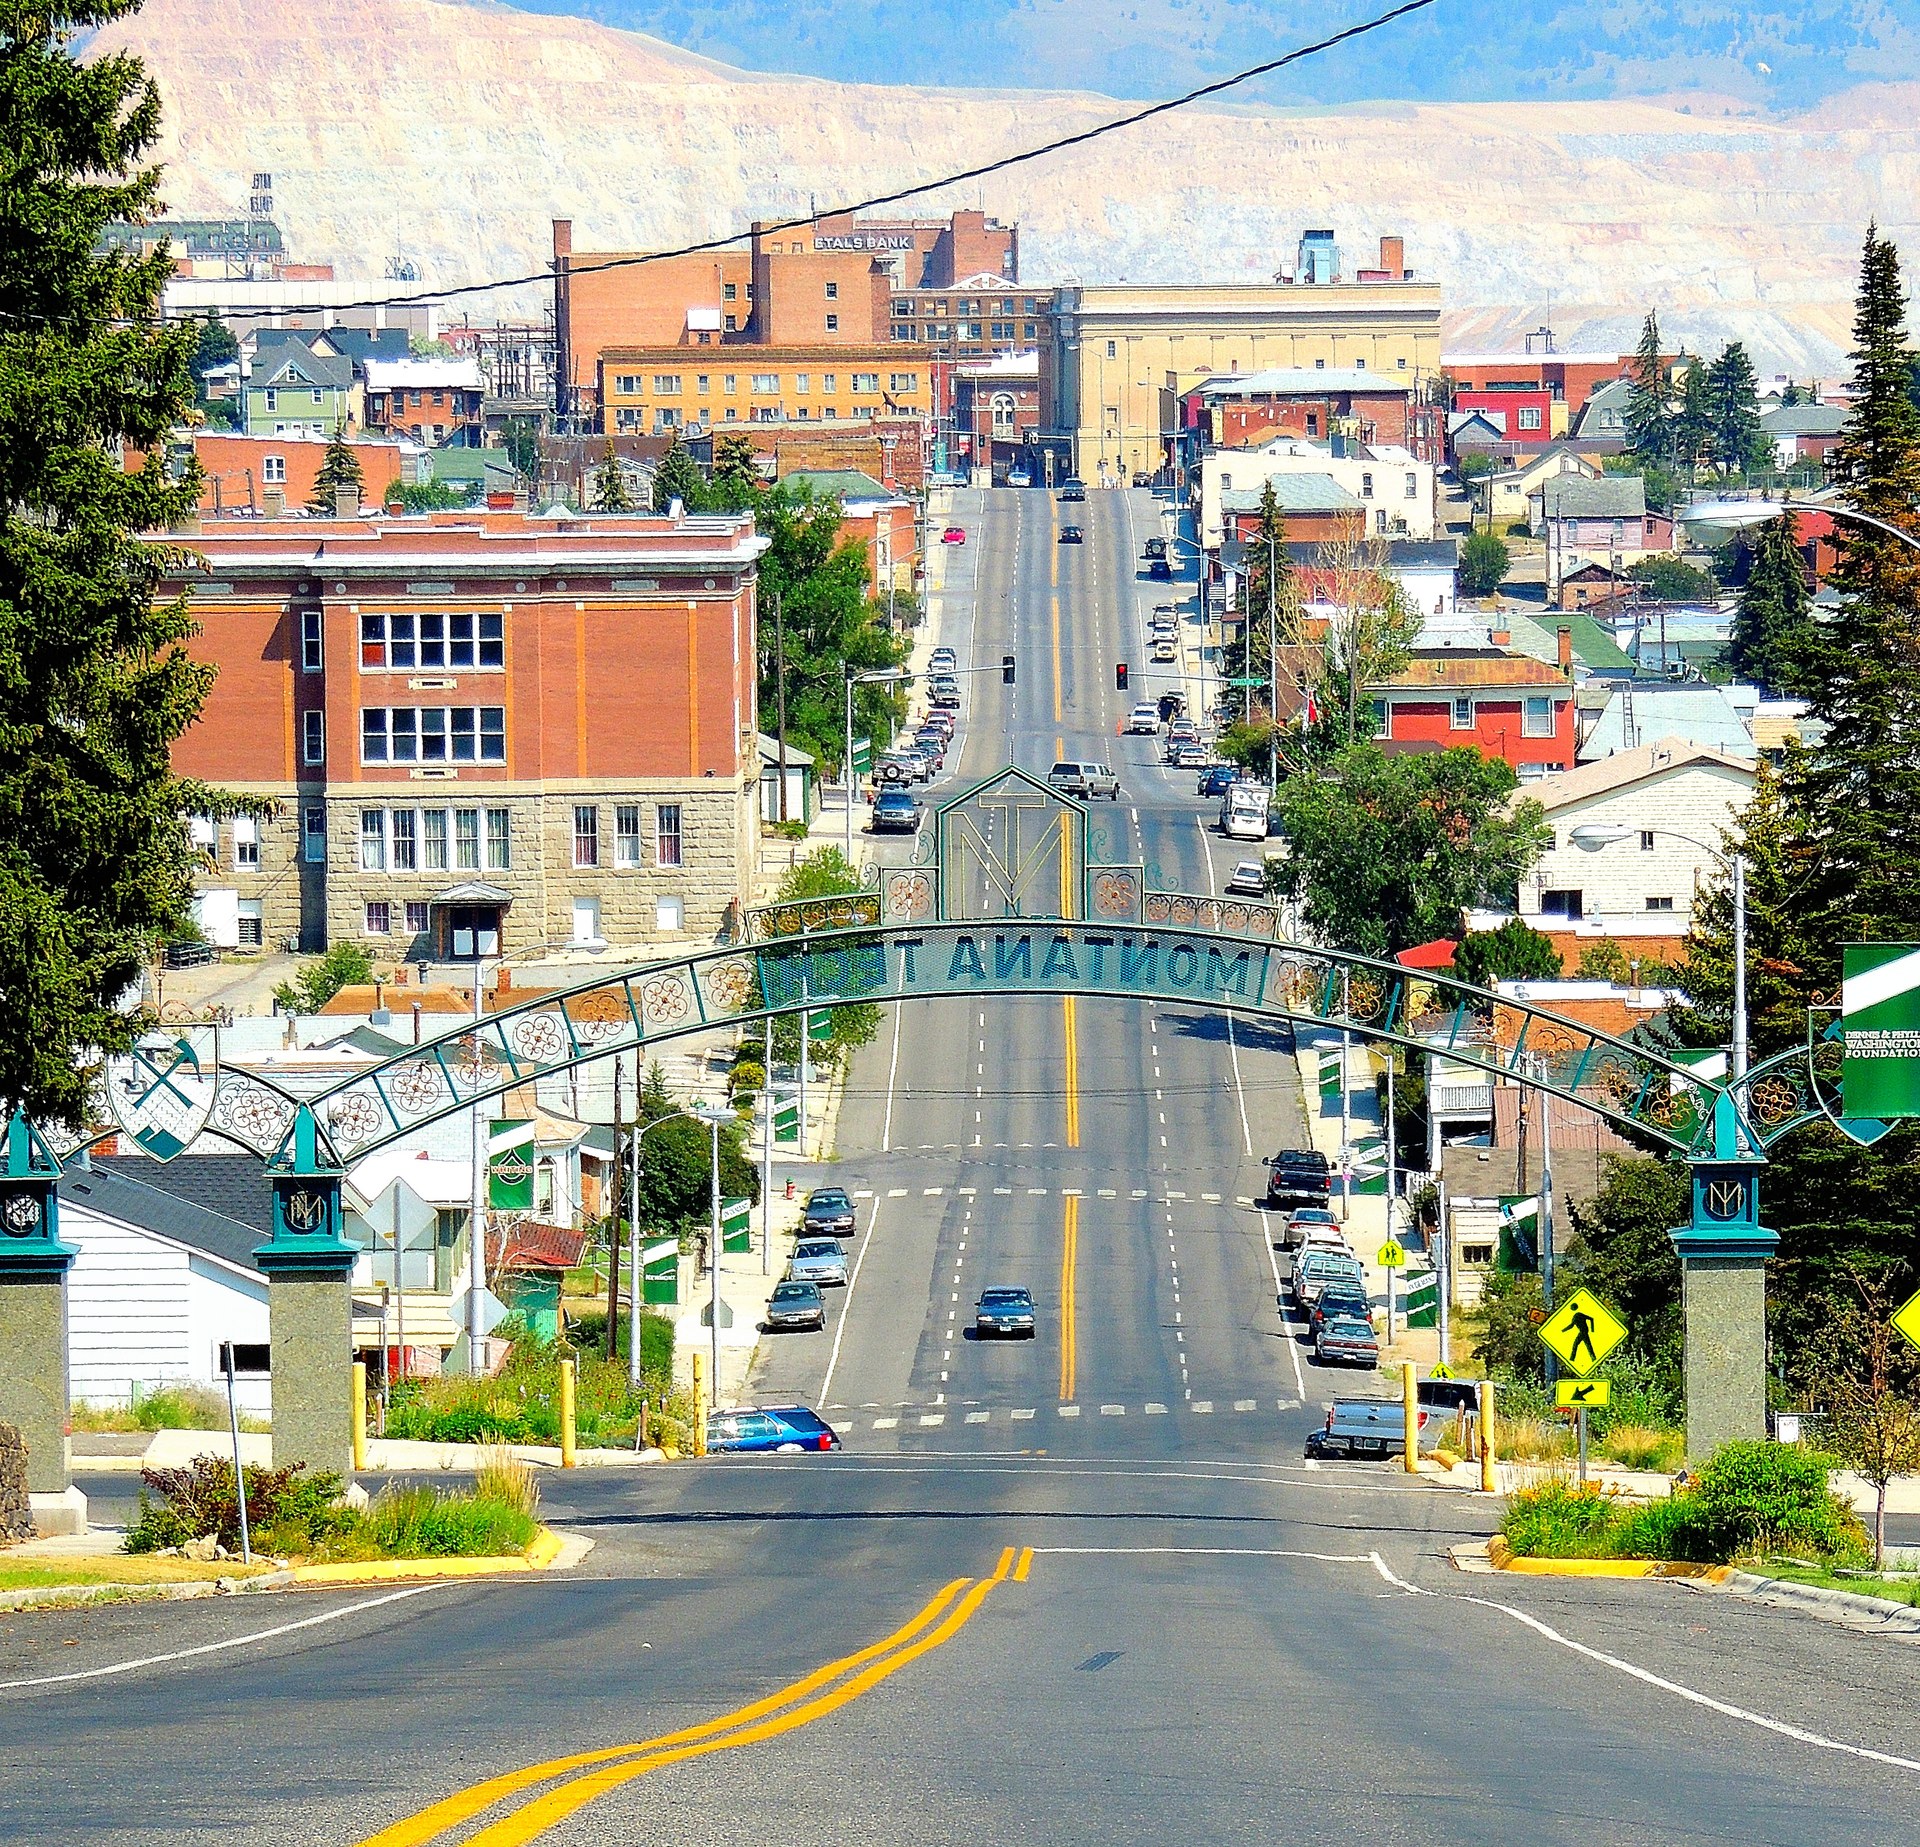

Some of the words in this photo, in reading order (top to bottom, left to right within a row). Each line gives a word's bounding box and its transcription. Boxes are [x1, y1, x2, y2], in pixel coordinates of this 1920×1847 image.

[814, 236, 863, 249] ETALS
[866, 236, 910, 249] BANK
[1844, 1030, 1880, 1039] DENNIS
[1881, 1029, 1891, 1039] &
[1892, 1030, 1920, 1039] PHYLL
[1844, 1049, 1920, 1059] FOUNDATIO
